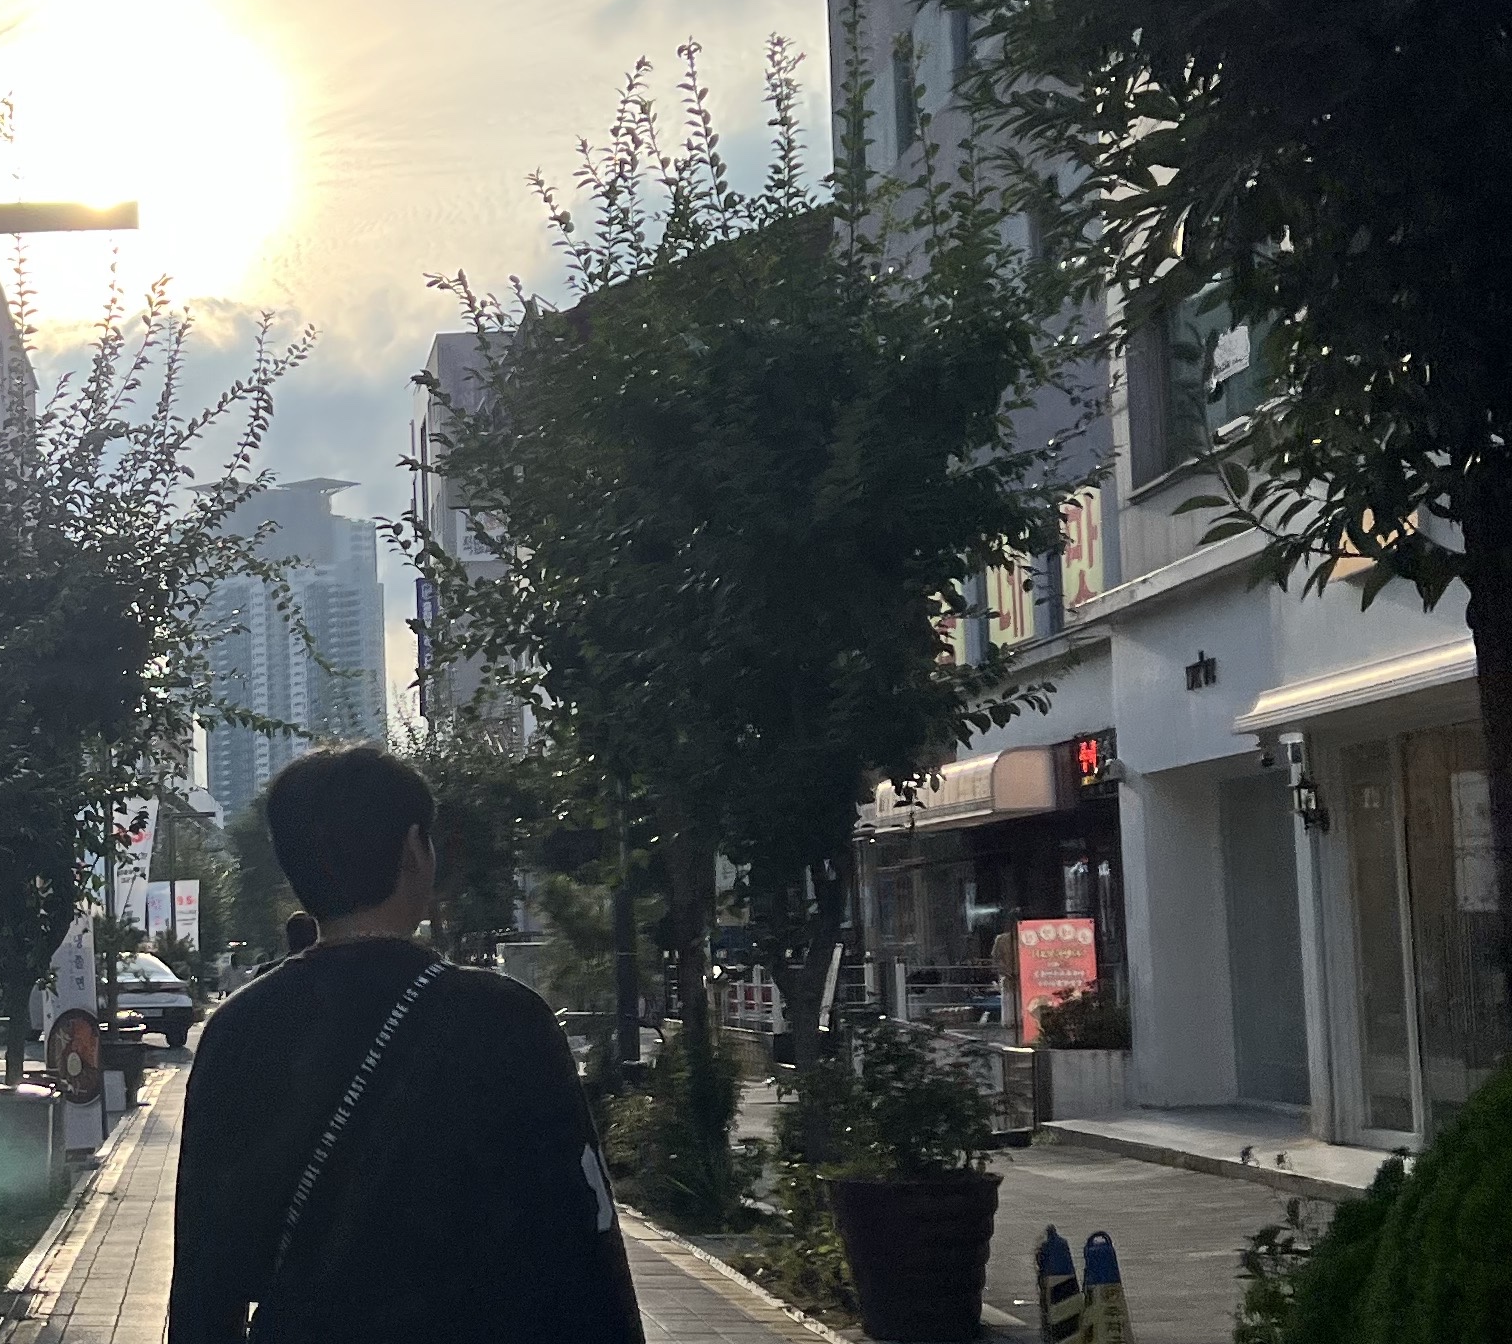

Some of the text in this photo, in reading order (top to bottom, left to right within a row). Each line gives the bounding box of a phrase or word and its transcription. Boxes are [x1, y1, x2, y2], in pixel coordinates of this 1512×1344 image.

[402, 988, 419, 1003] IS
[375, 1002, 409, 1049] FUTURE
[360, 1049, 382, 1074] THE
[343, 1074, 367, 1106] PAST
[329, 1106, 351, 1131] THE
[321, 1131, 338, 1147] IN
[313, 1147, 329, 1163] IS
[292, 1163, 321, 1207] FUTURE
